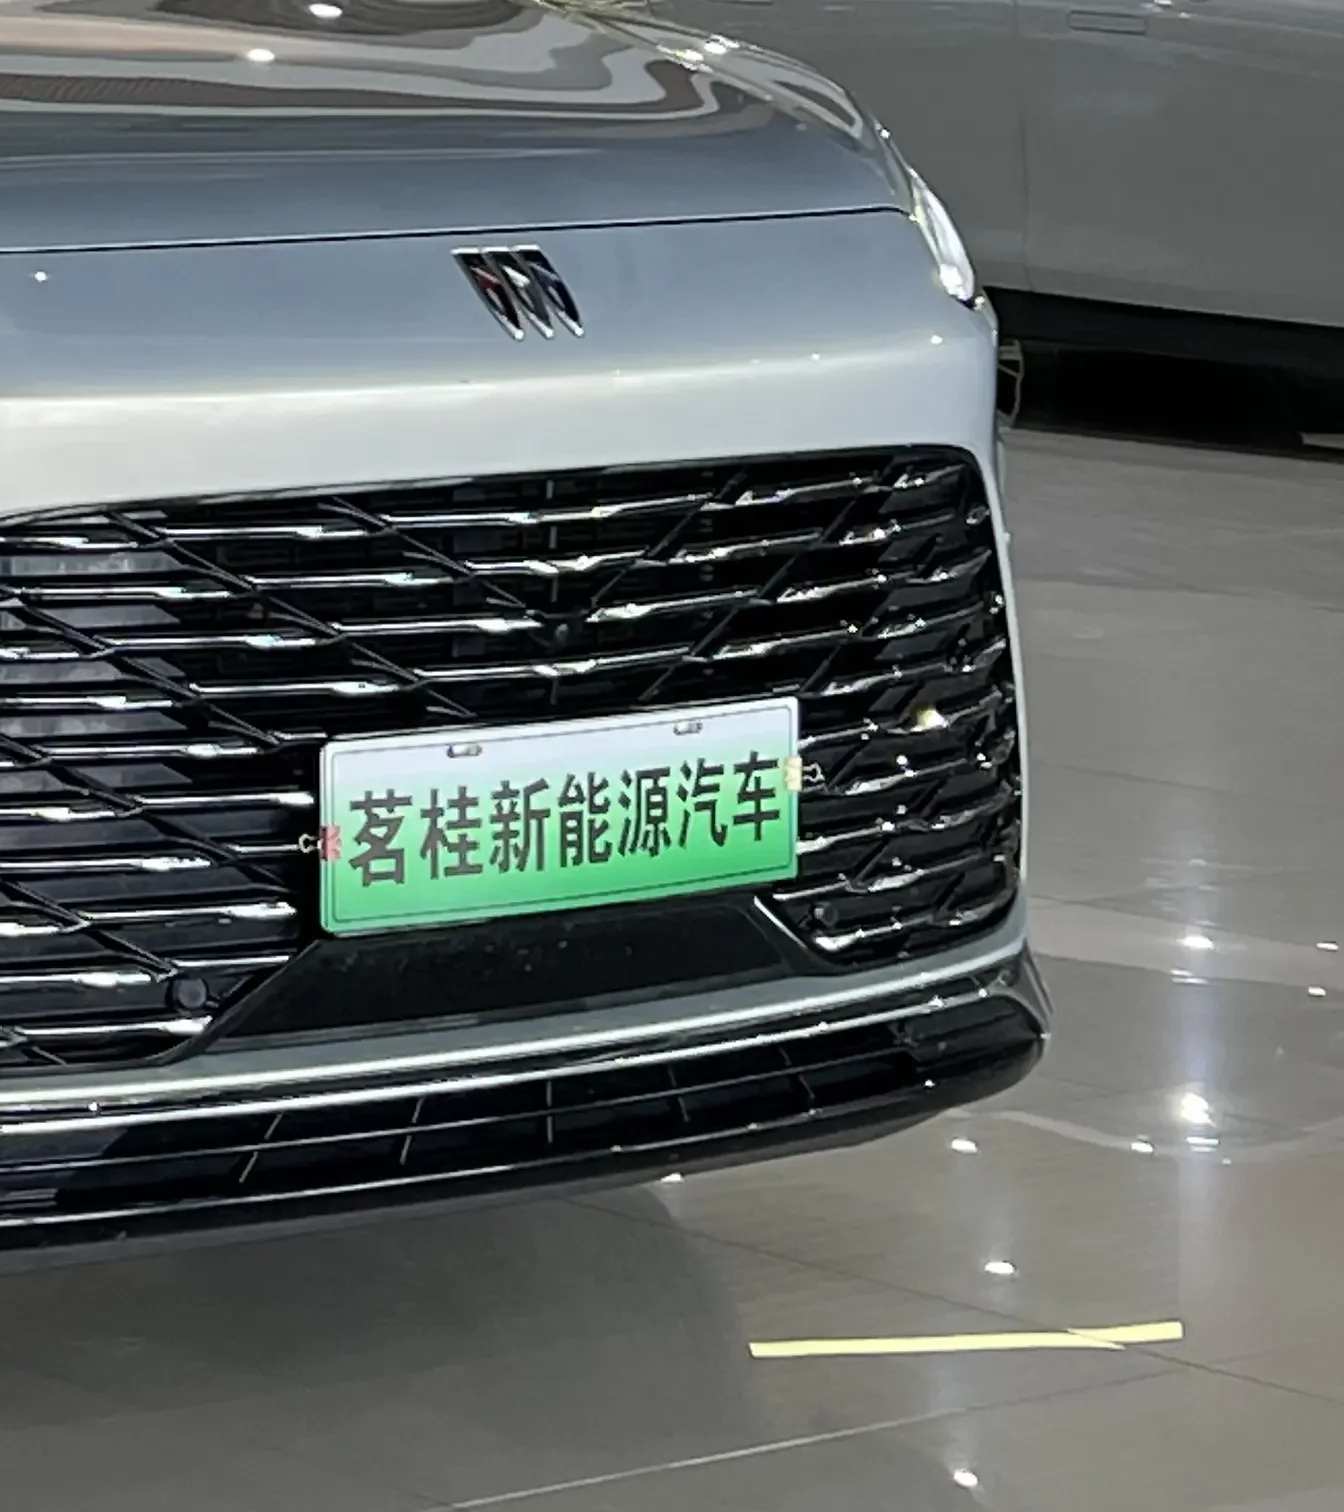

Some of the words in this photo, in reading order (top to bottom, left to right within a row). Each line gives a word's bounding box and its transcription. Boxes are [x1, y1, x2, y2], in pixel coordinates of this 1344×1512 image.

[348, 750, 781, 888] 茗桂新能源汽车
